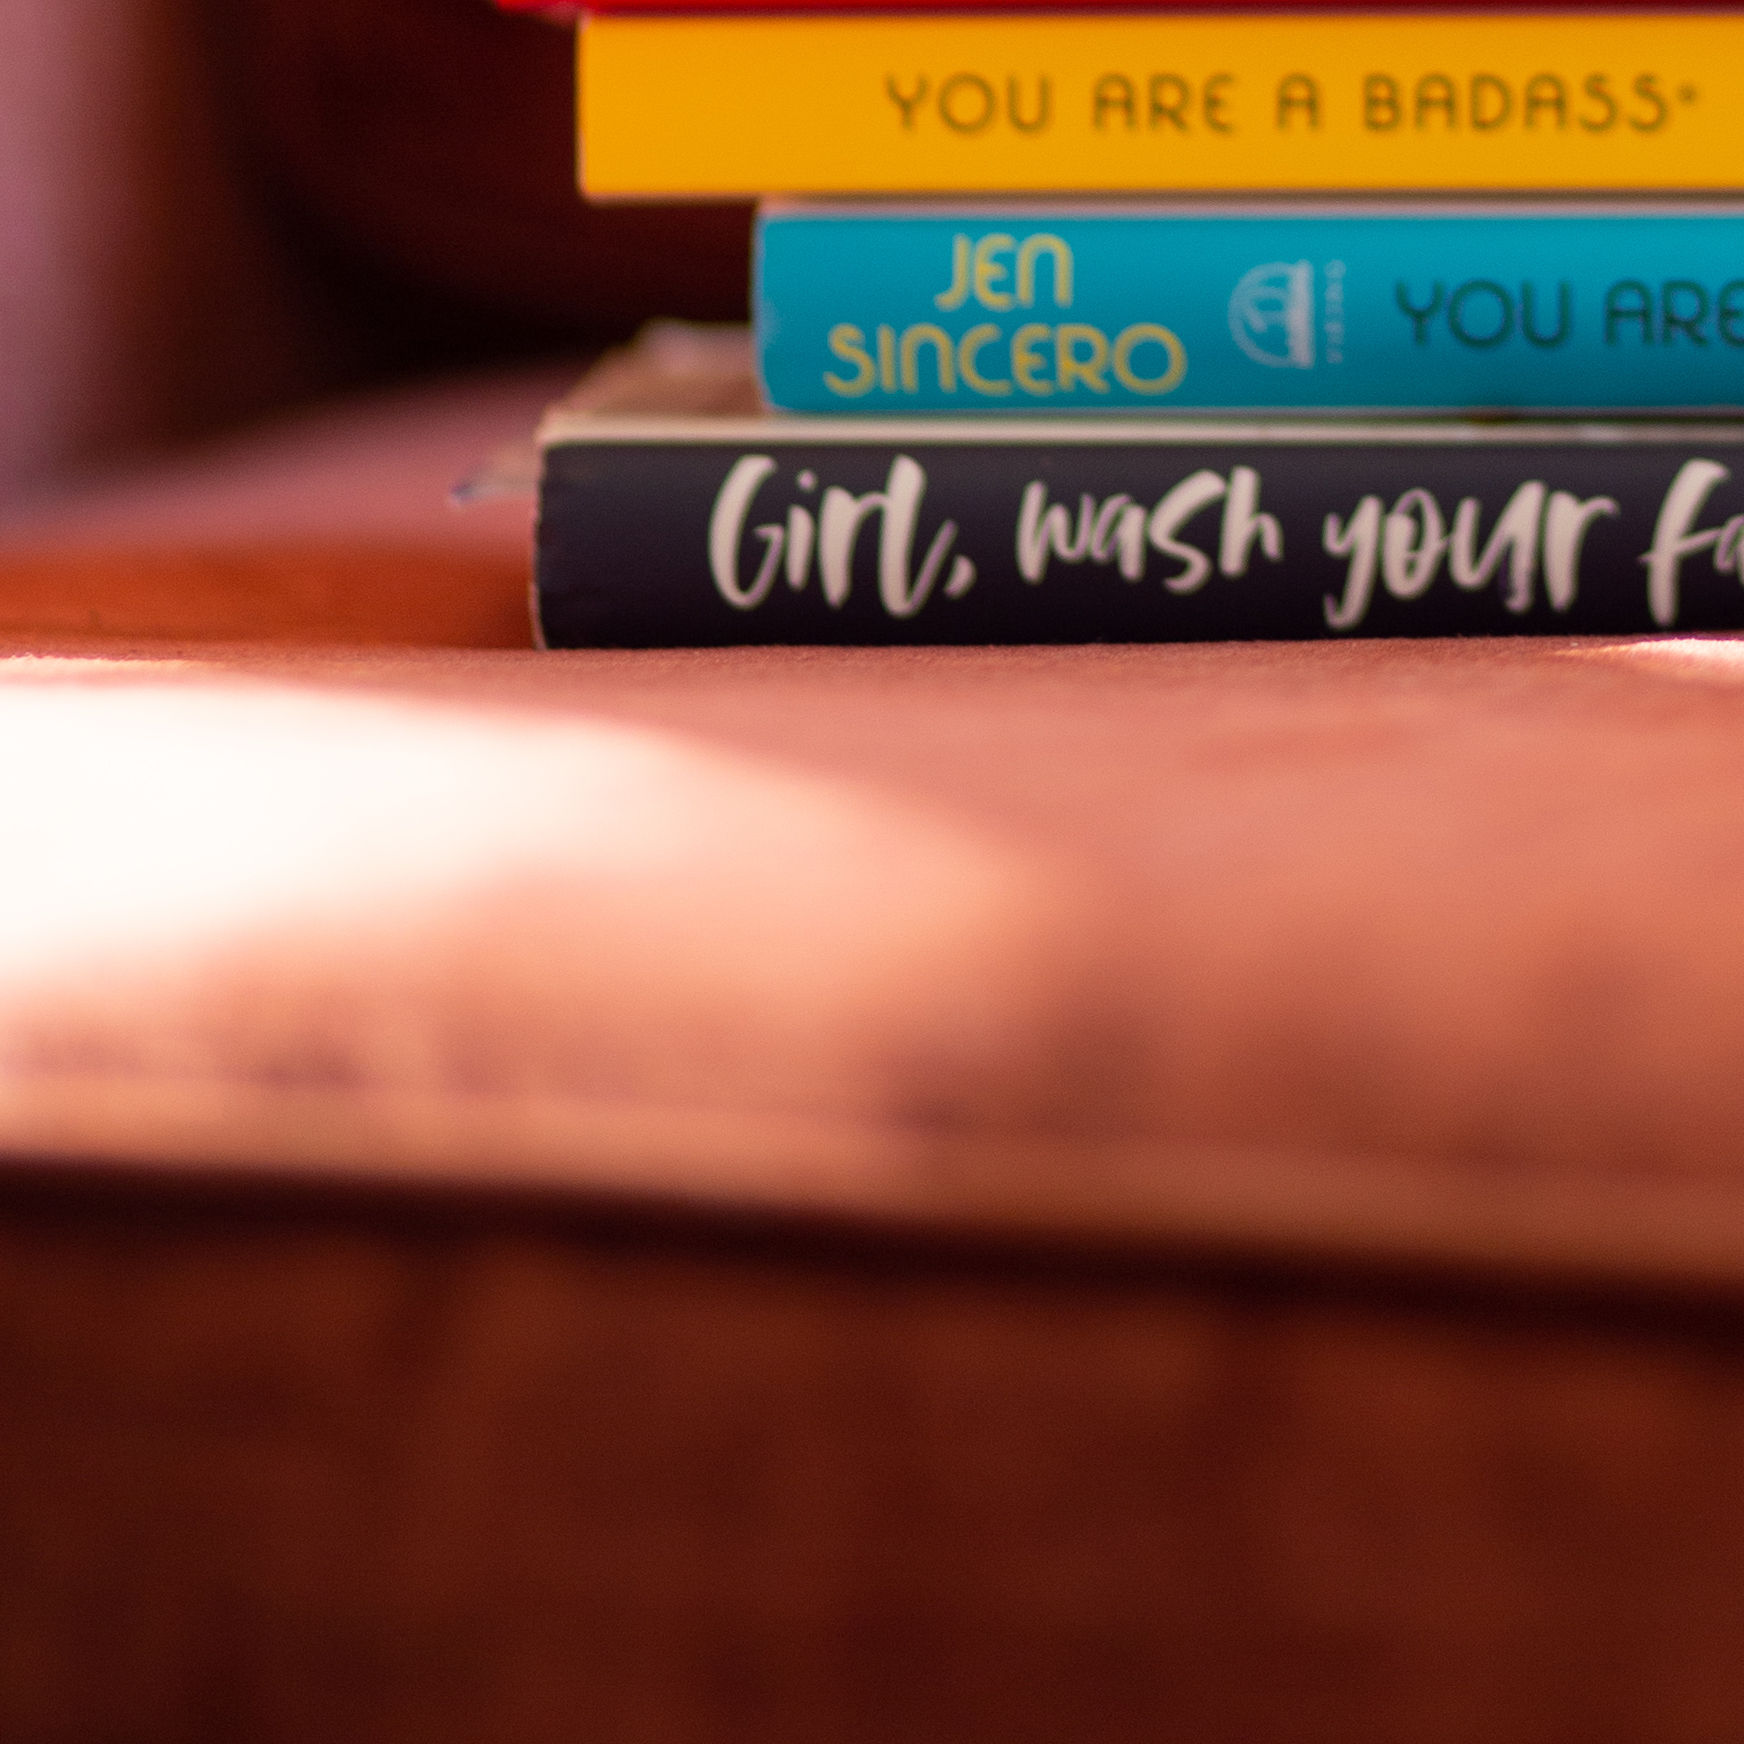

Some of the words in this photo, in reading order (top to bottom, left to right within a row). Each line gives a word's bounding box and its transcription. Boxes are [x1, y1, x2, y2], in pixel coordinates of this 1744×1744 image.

[883, 71, 1053, 135] YOU
[1090, 72, 1238, 135] ARE
[1274, 72, 1325, 135] A
[933, 233, 1073, 310] JEN
[1396, 279, 1572, 349] YOU
[822, 323, 1188, 396] SINCERO
[707, 454, 977, 617] Girl,
[1016, 465, 1283, 593] wash
[1322, 479, 1621, 629] your
